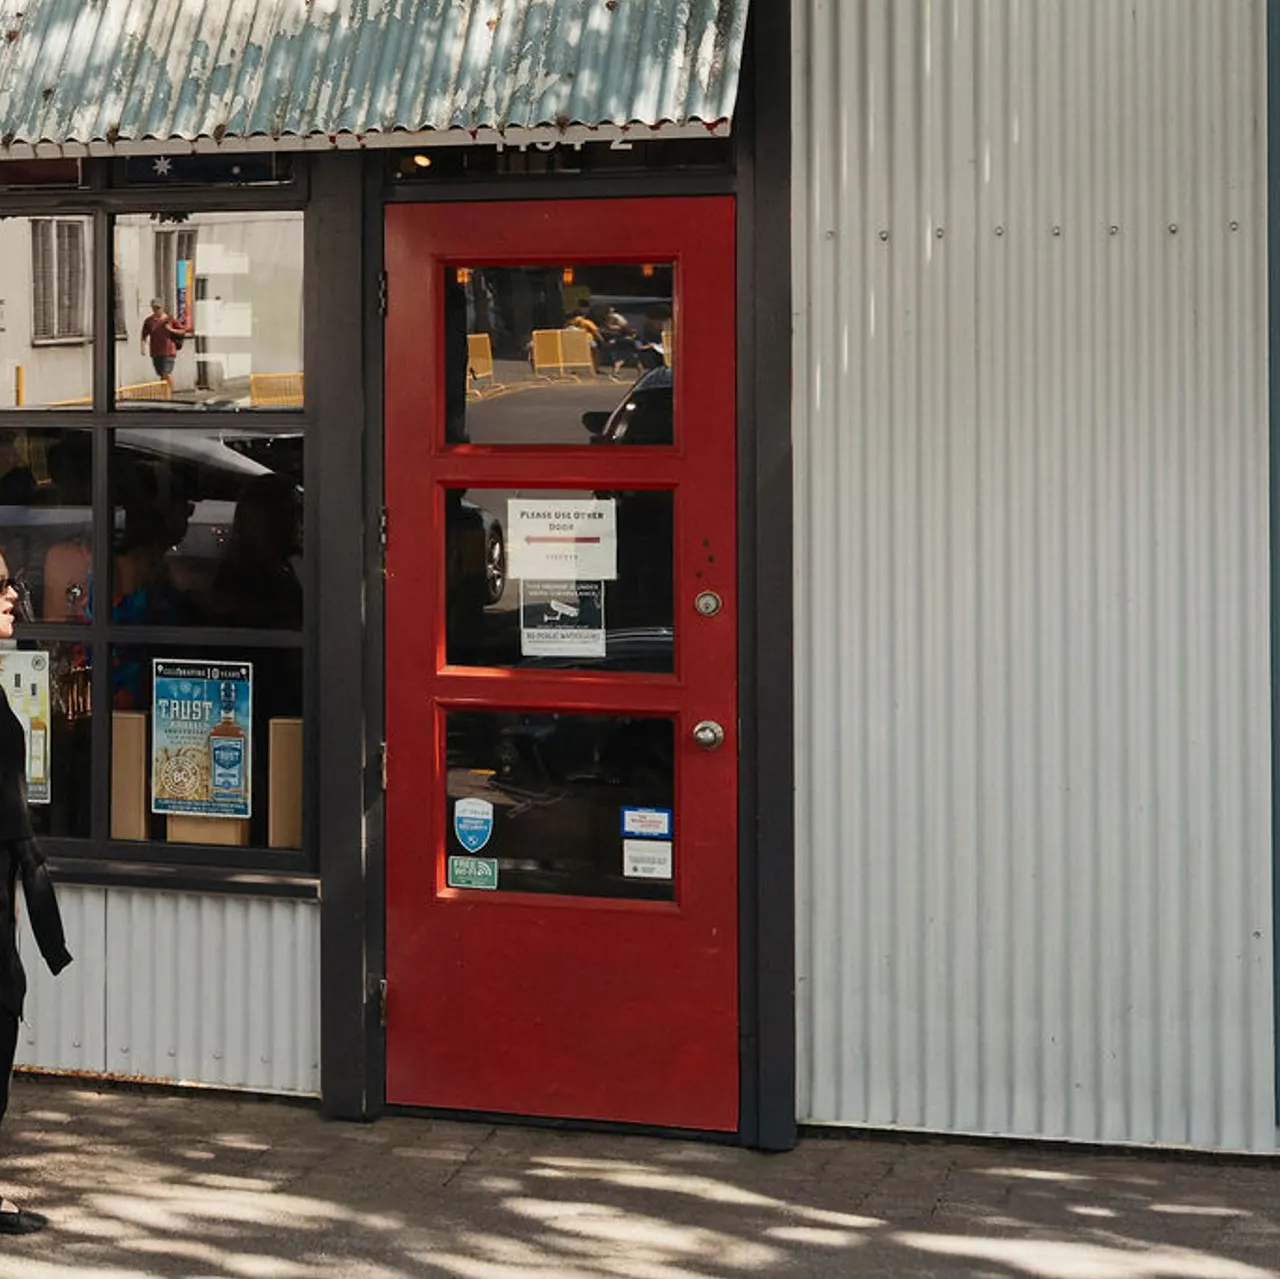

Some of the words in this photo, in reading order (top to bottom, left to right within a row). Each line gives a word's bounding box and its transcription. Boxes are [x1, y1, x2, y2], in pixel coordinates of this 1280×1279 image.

[520, 511, 552, 519] PLEASE
[554, 512, 571, 520] USE
[573, 513, 604, 521] OTHER
[548, 523, 575, 532] DOOR
[158, 699, 213, 721] TRUST
